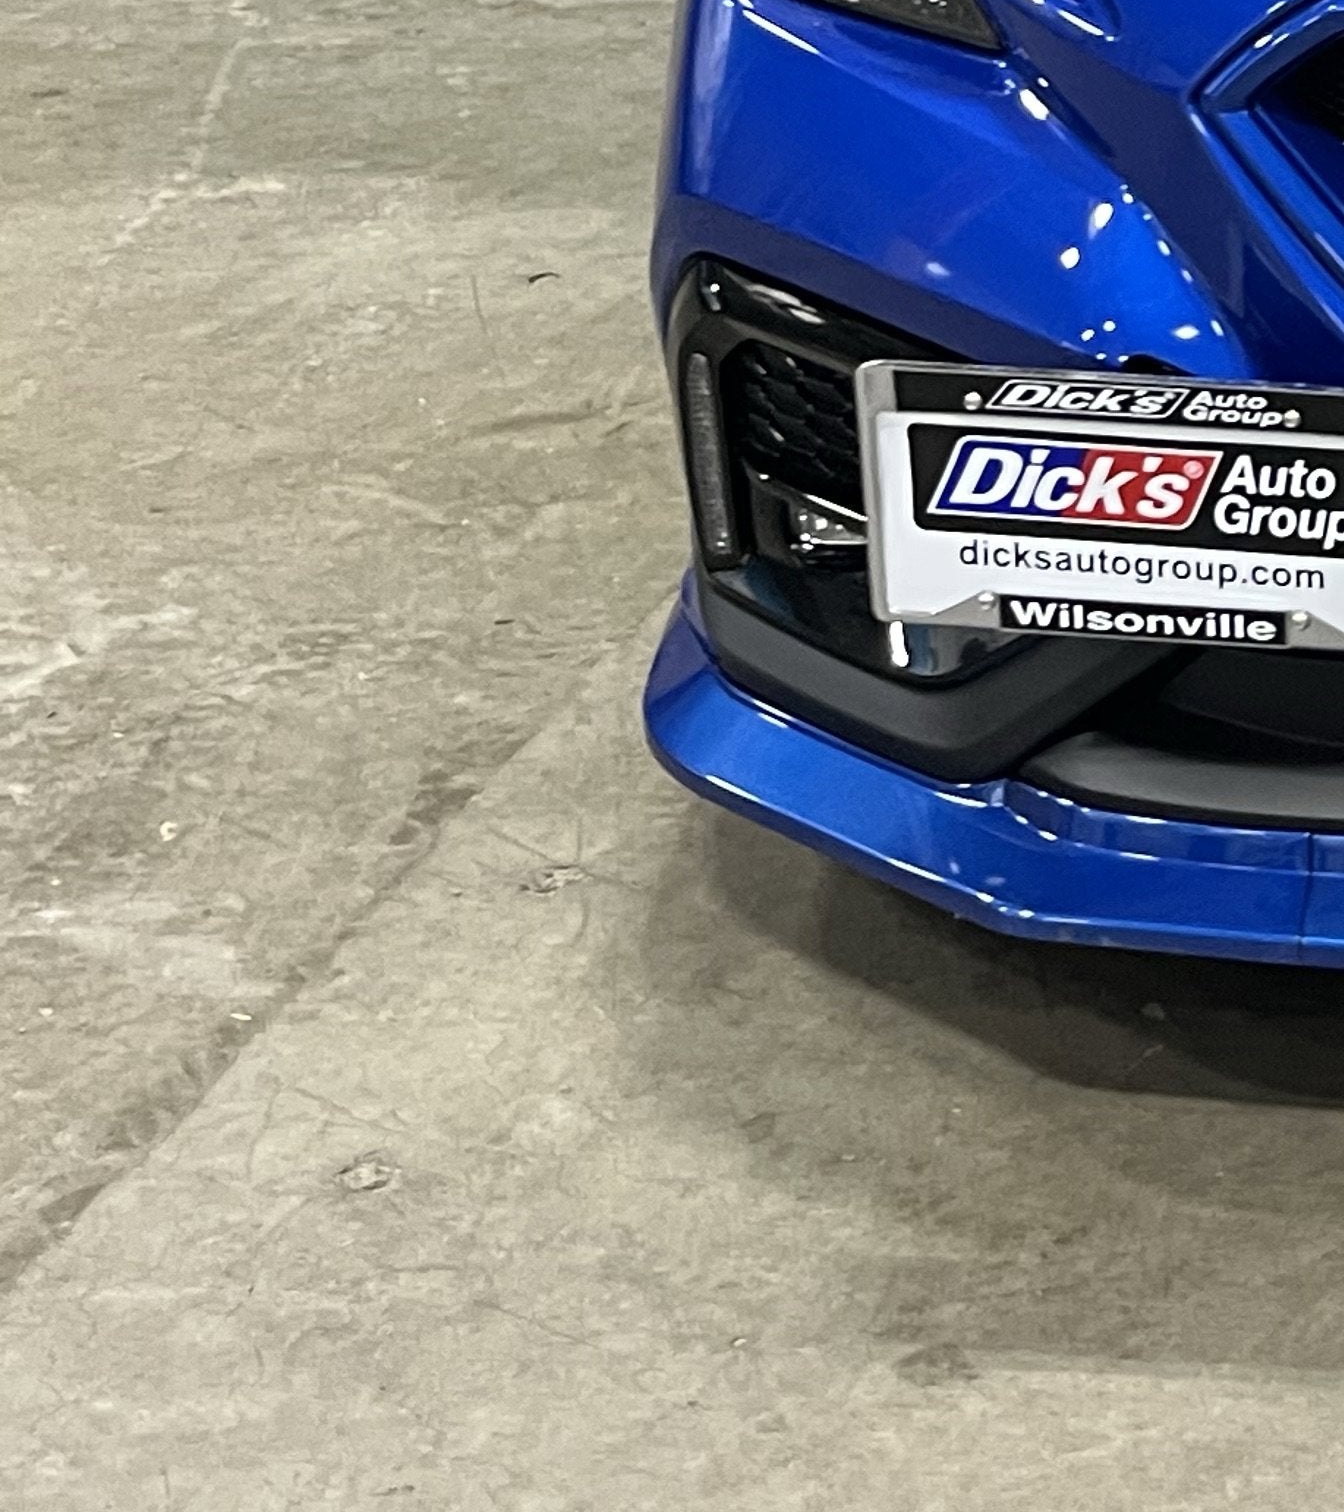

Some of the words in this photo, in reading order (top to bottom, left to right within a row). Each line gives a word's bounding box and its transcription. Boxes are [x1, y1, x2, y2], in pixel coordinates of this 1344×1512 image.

[1001, 383, 1171, 413] Dick's
[1183, 405, 1283, 428] Group
[1191, 390, 1268, 409] Auto
[949, 447, 1181, 520] Dick's
[1221, 455, 1336, 499] Auto
[960, 540, 1325, 589] dicksautogroup.com
[1010, 600, 1277, 640] Wilsonville
